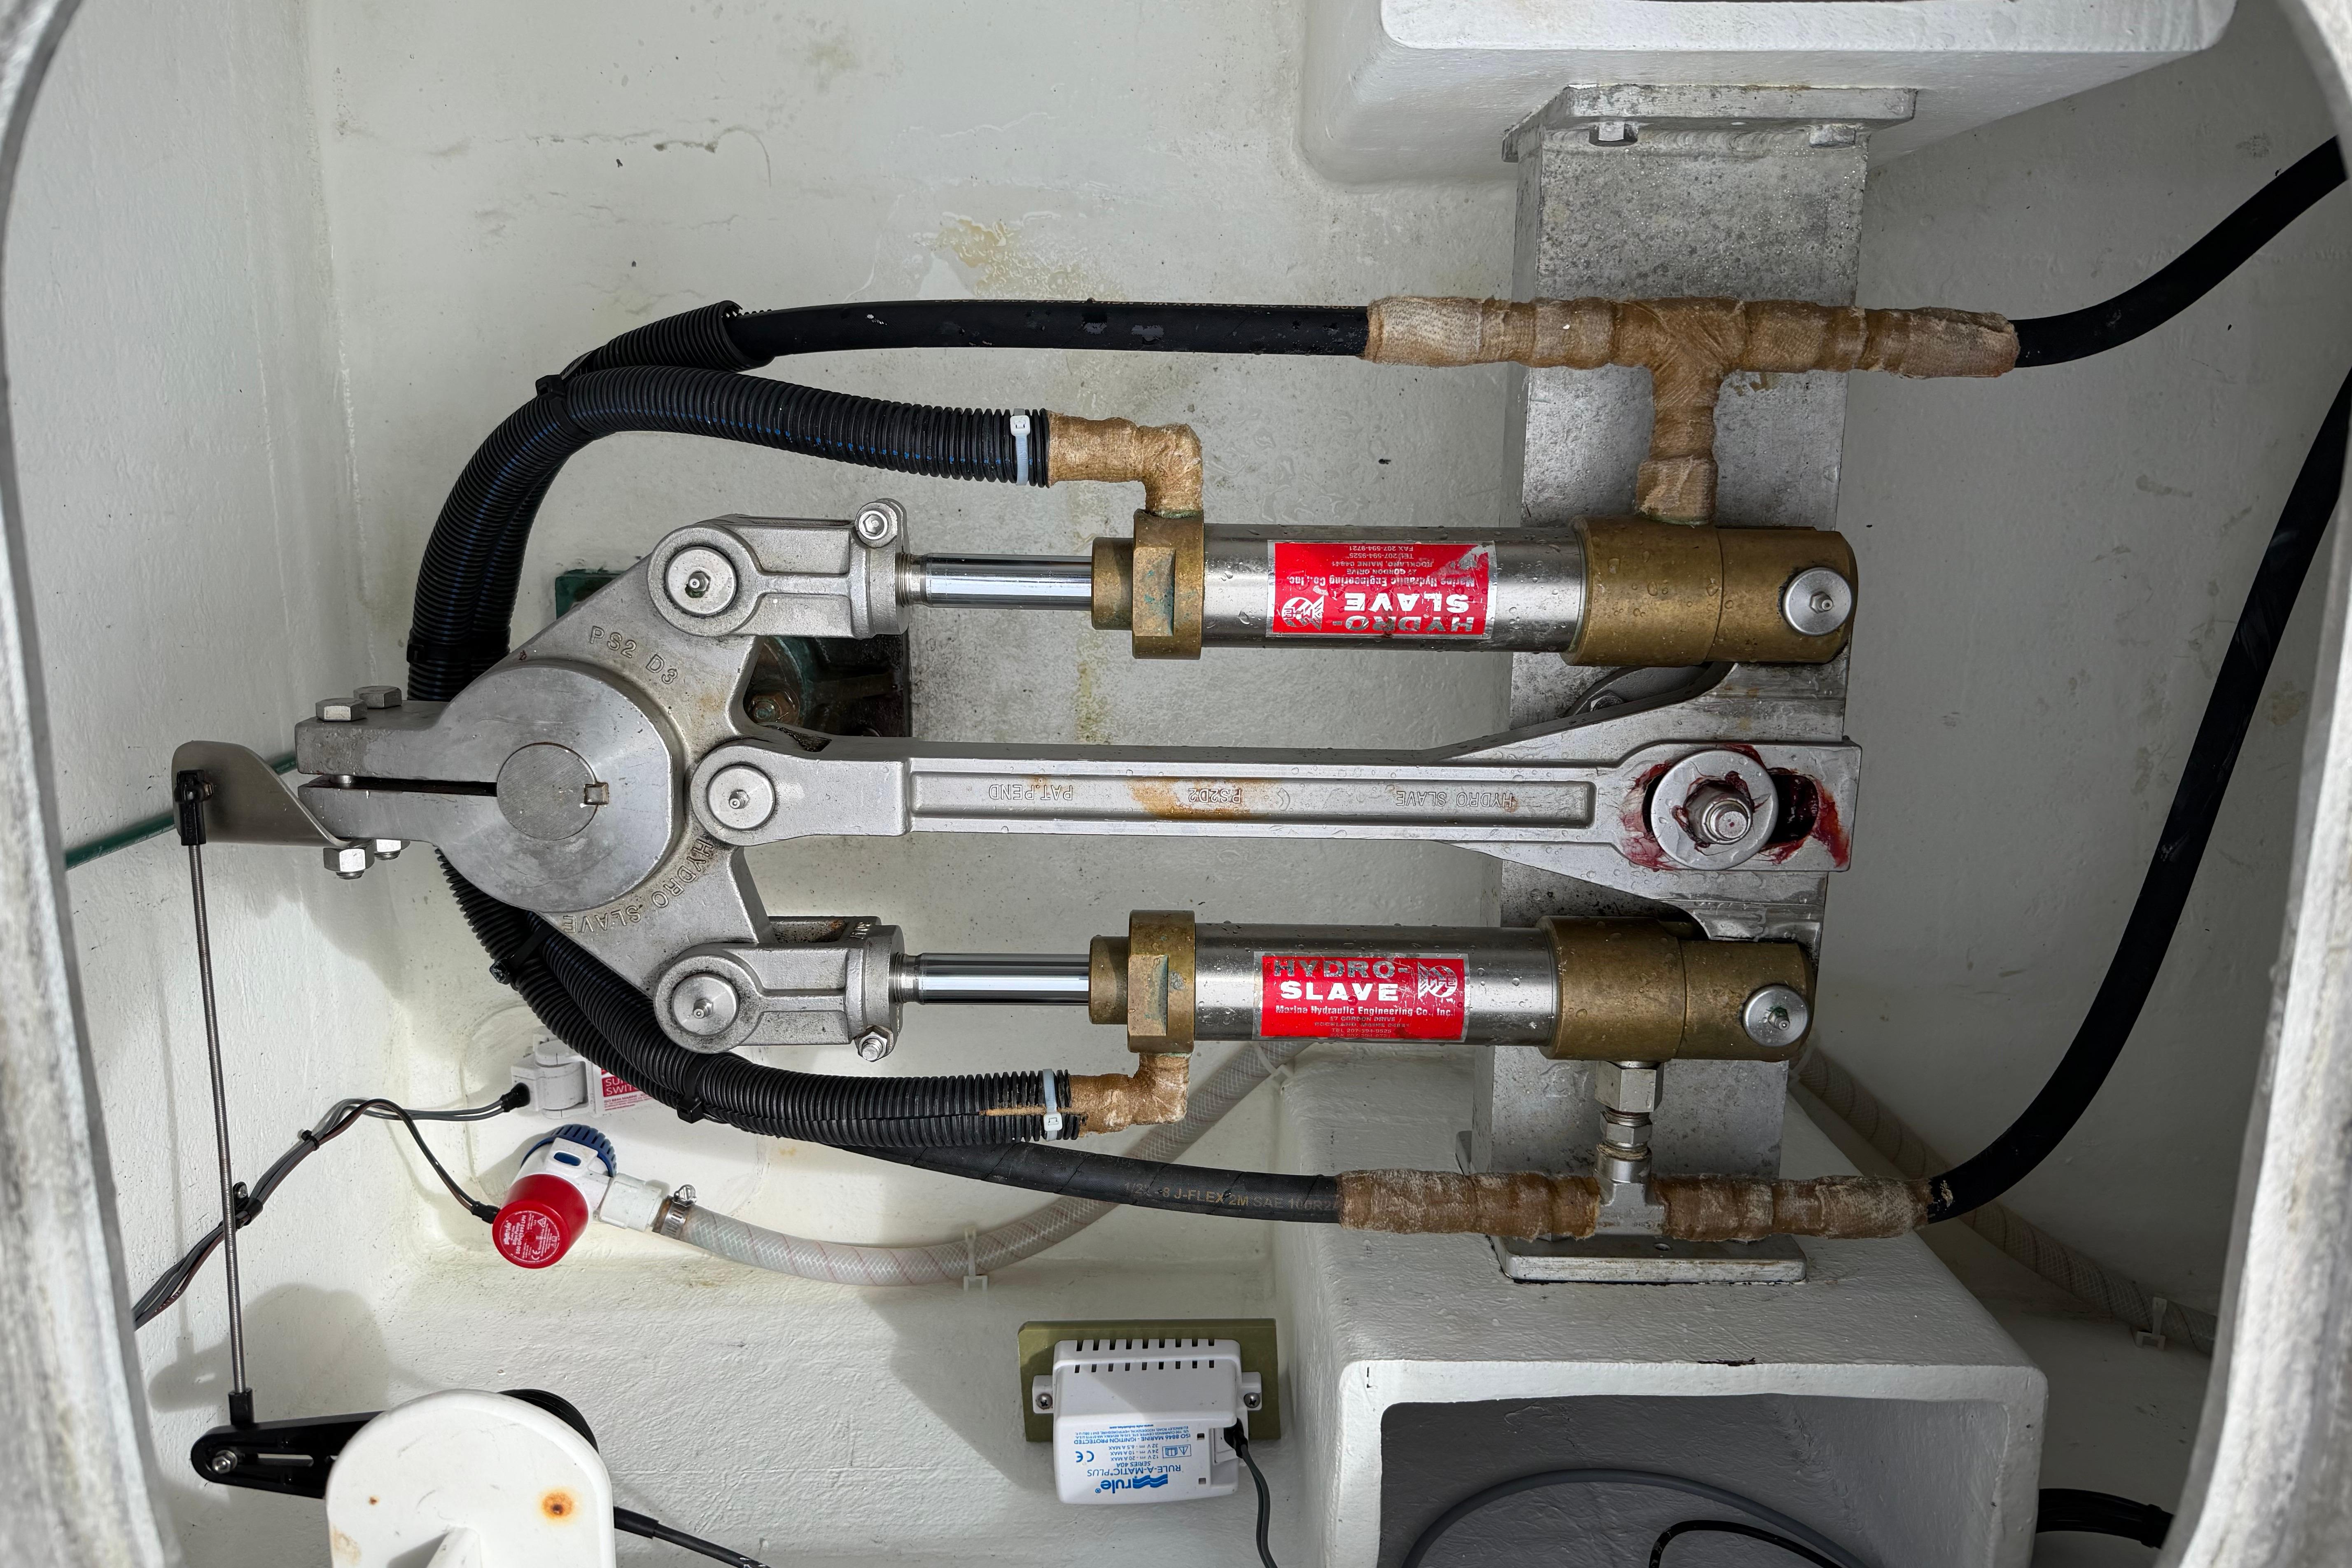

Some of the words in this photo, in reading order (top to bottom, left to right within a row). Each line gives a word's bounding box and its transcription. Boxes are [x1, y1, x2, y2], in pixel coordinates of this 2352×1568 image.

[1286, 576, 1304, 586] Inc.
[1329, 574, 1387, 587] Engineering
[1344, 593, 1469, 614] SLAVE
[1332, 615, 1475, 632] HYDRO-
[589, 625, 637, 658] PS2
[645, 653, 679, 685] D3
[1188, 788, 1242, 804] PS2D2
[1395, 791, 1446, 807] SLAVE
[1456, 792, 1513, 808] HYDRO
[651, 838, 714, 908] HYDRO
[562, 905, 642, 934] SLAVE
[1274, 960, 1408, 978] HYDRO-
[1280, 980, 1398, 1001] SLAVE
[1276, 1005, 1308, 1014] Marine
[1311, 1006, 1354, 1015] Hydraulic
[1358, 1006, 1413, 1017] Engineering
[1436, 1008, 1453, 1016] Inc.
[607, 1084, 638, 1095] SWIT
[1174, 1188, 1224, 1204] J-FLEX
